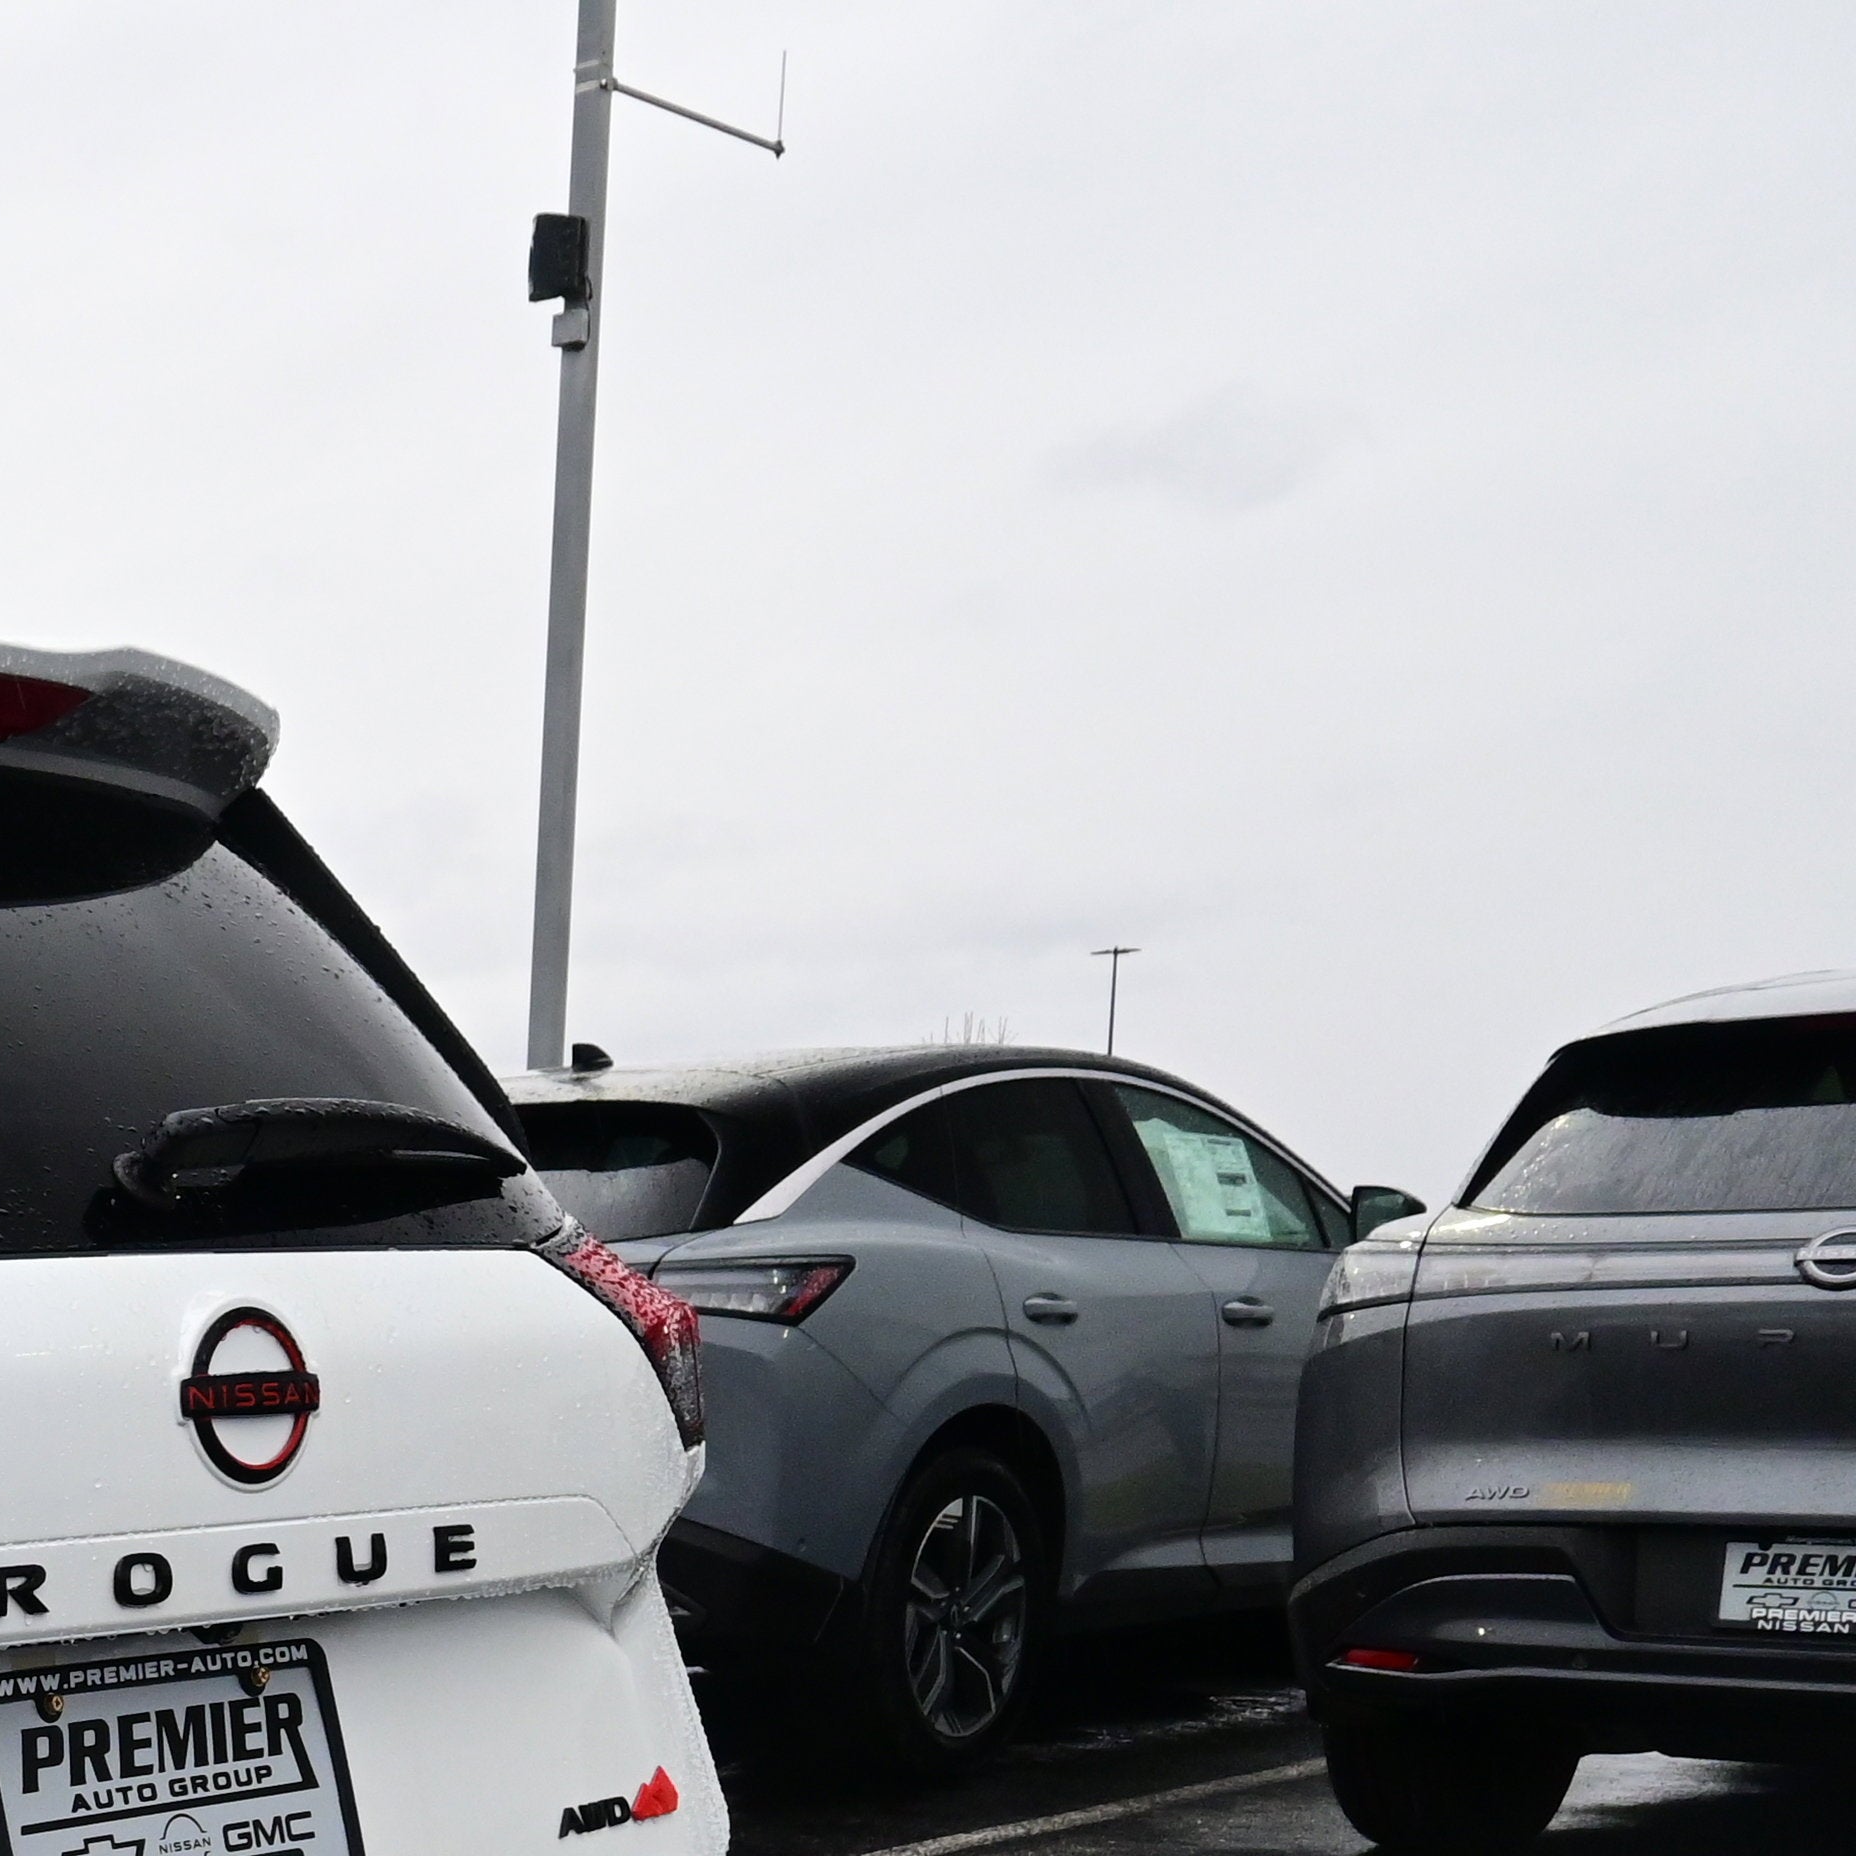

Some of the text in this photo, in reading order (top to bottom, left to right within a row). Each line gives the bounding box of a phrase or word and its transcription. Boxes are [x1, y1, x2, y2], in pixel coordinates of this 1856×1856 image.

[188, 1381, 320, 1410] NISSAN
[1465, 1485, 1530, 1501] AWD
[1740, 1552, 1856, 1577] PREM
[1762, 1577, 1815, 1586] AUTO
[1751, 1607, 1856, 1623] PREMIER
[1757, 1619, 1850, 1634] NISSAN
[20, 1691, 320, 1795] PREMIER
[71, 1764, 273, 1814] AUTO GROUP
[558, 1796, 632, 1839] AWD
[159, 1811, 316, 1855] NISSAN GMC
